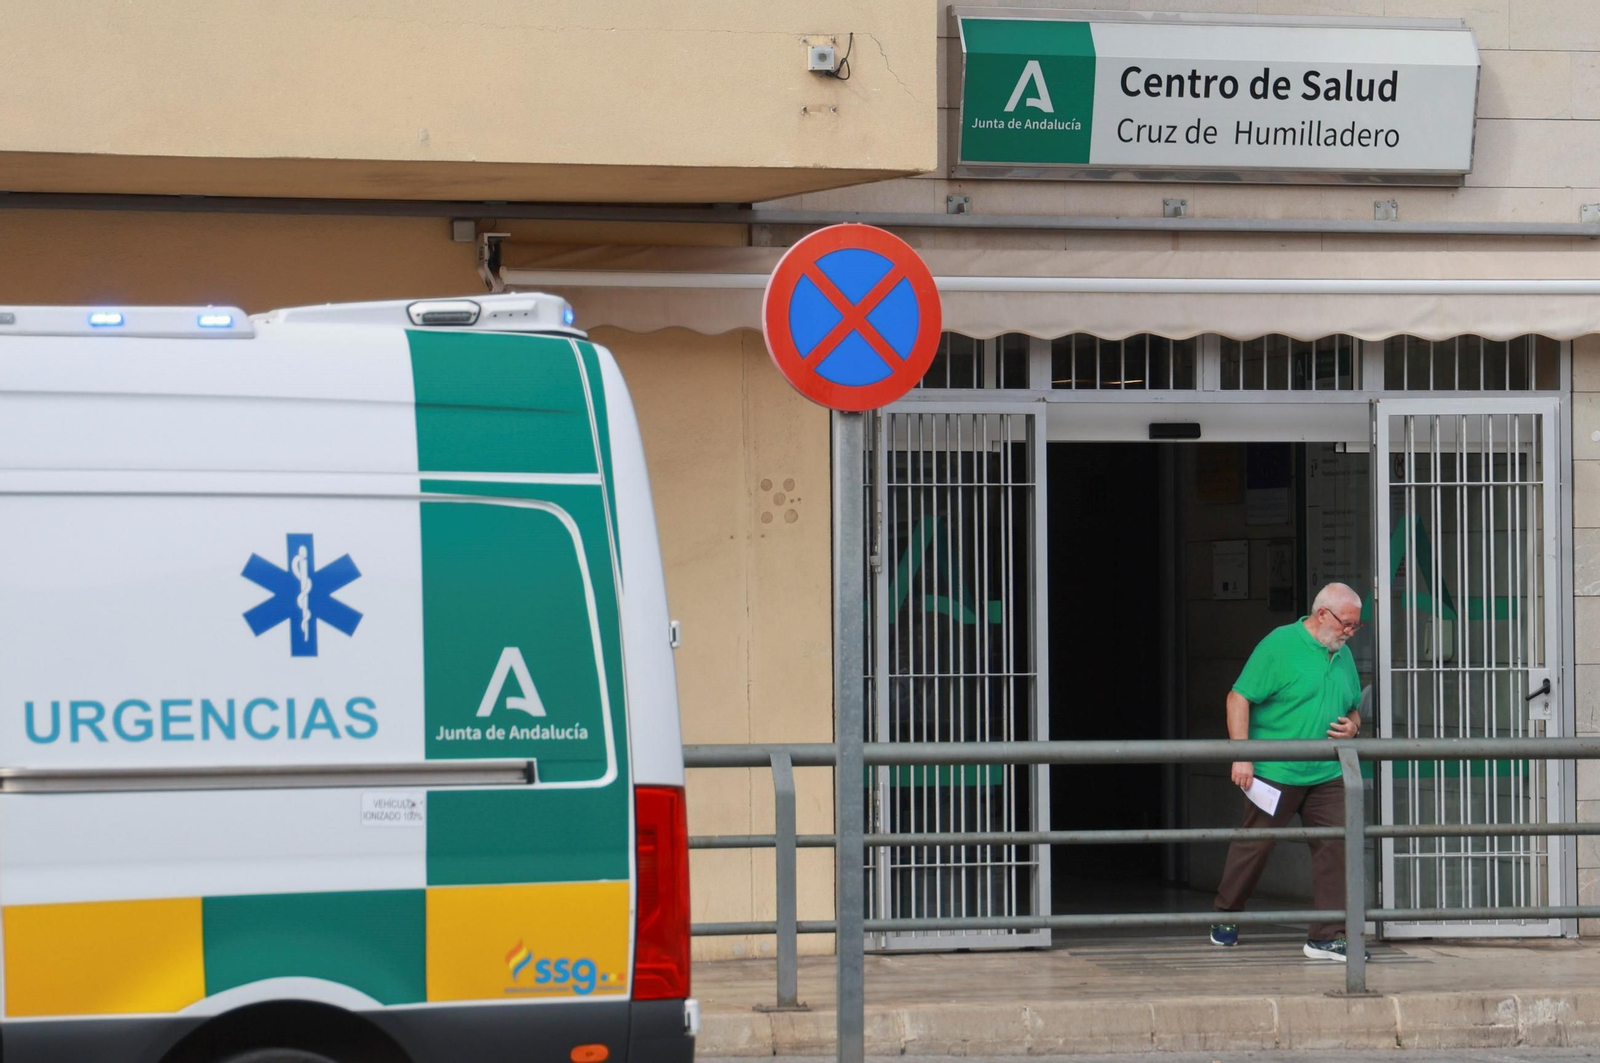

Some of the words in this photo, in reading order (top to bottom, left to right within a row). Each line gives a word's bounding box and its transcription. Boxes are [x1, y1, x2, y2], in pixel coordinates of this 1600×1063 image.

[1120, 66, 1239, 99] Centro
[1249, 67, 1291, 101] de
[1301, 69, 1398, 102] Salud
[971, 118, 1005, 129] Junta
[1007, 118, 1022, 129] de
[1024, 118, 1082, 131] Andalucía
[1117, 118, 1177, 144] Cruz
[1185, 118, 1218, 145] de
[1234, 120, 1400, 148] Humilladero
[24, 697, 379, 744] URGENCIAS
[435, 725, 481, 740] Junta
[485, 724, 506, 739] de
[509, 722, 589, 740] Andalucía
[363, 811, 401, 821] IONIZADO
[534, 958, 597, 995] ssg
